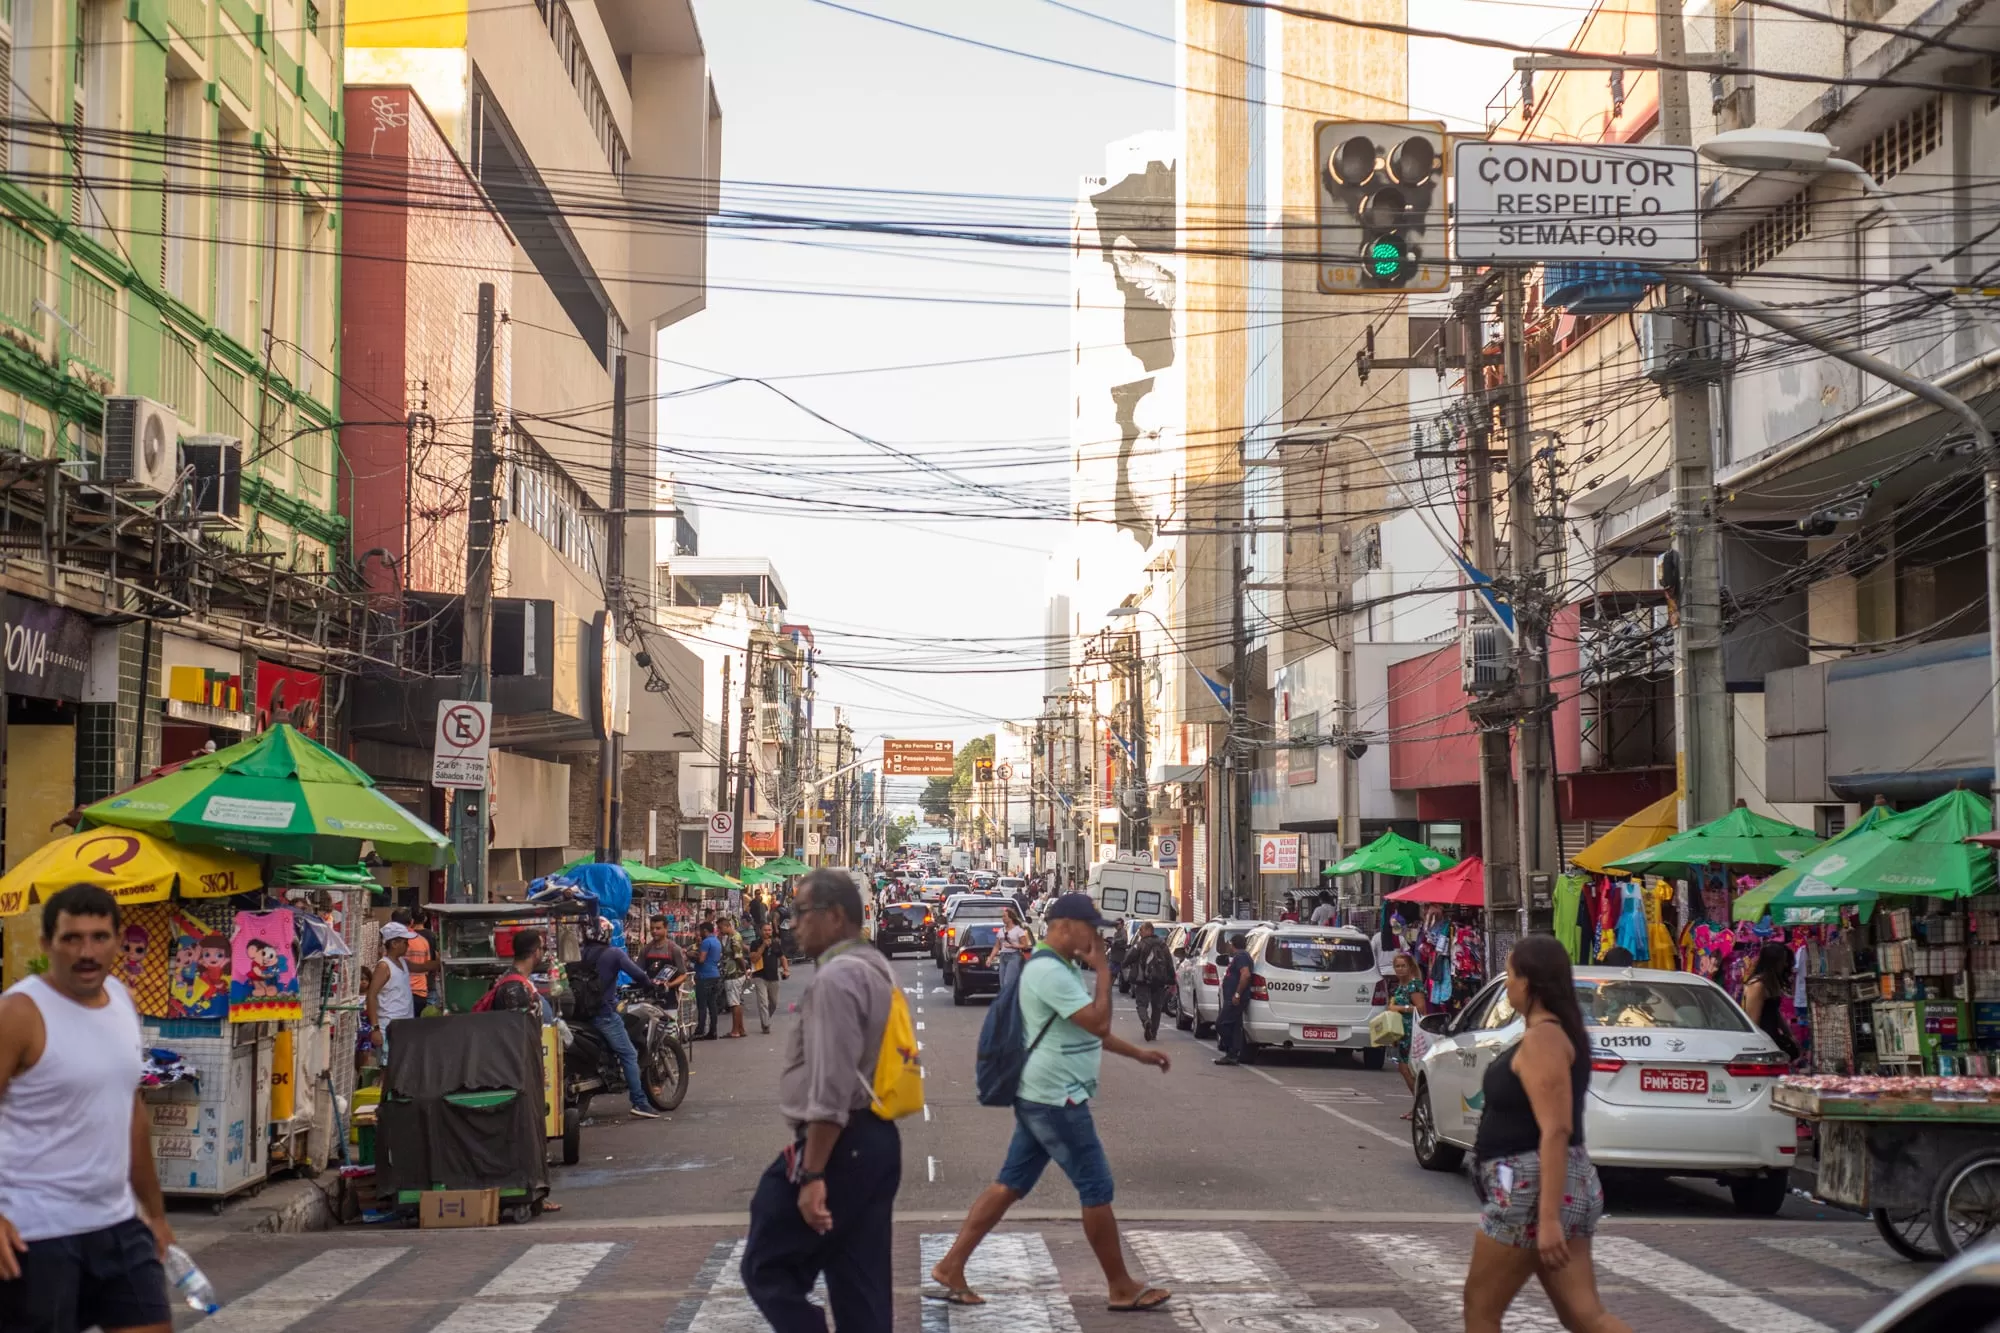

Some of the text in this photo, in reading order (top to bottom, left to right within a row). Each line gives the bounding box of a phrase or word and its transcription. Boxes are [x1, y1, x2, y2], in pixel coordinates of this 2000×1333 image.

[1478, 156, 1675, 186] CONDUTOR
[1497, 193, 1661, 217] RESPEITE O
[1498, 220, 1657, 247] SEMÁFORO
[199, 871, 239, 893] SKOL
[1878, 874, 1908, 884] AQUI
[1267, 981, 1310, 992] 002097
[1600, 1035, 1652, 1048] 013110
